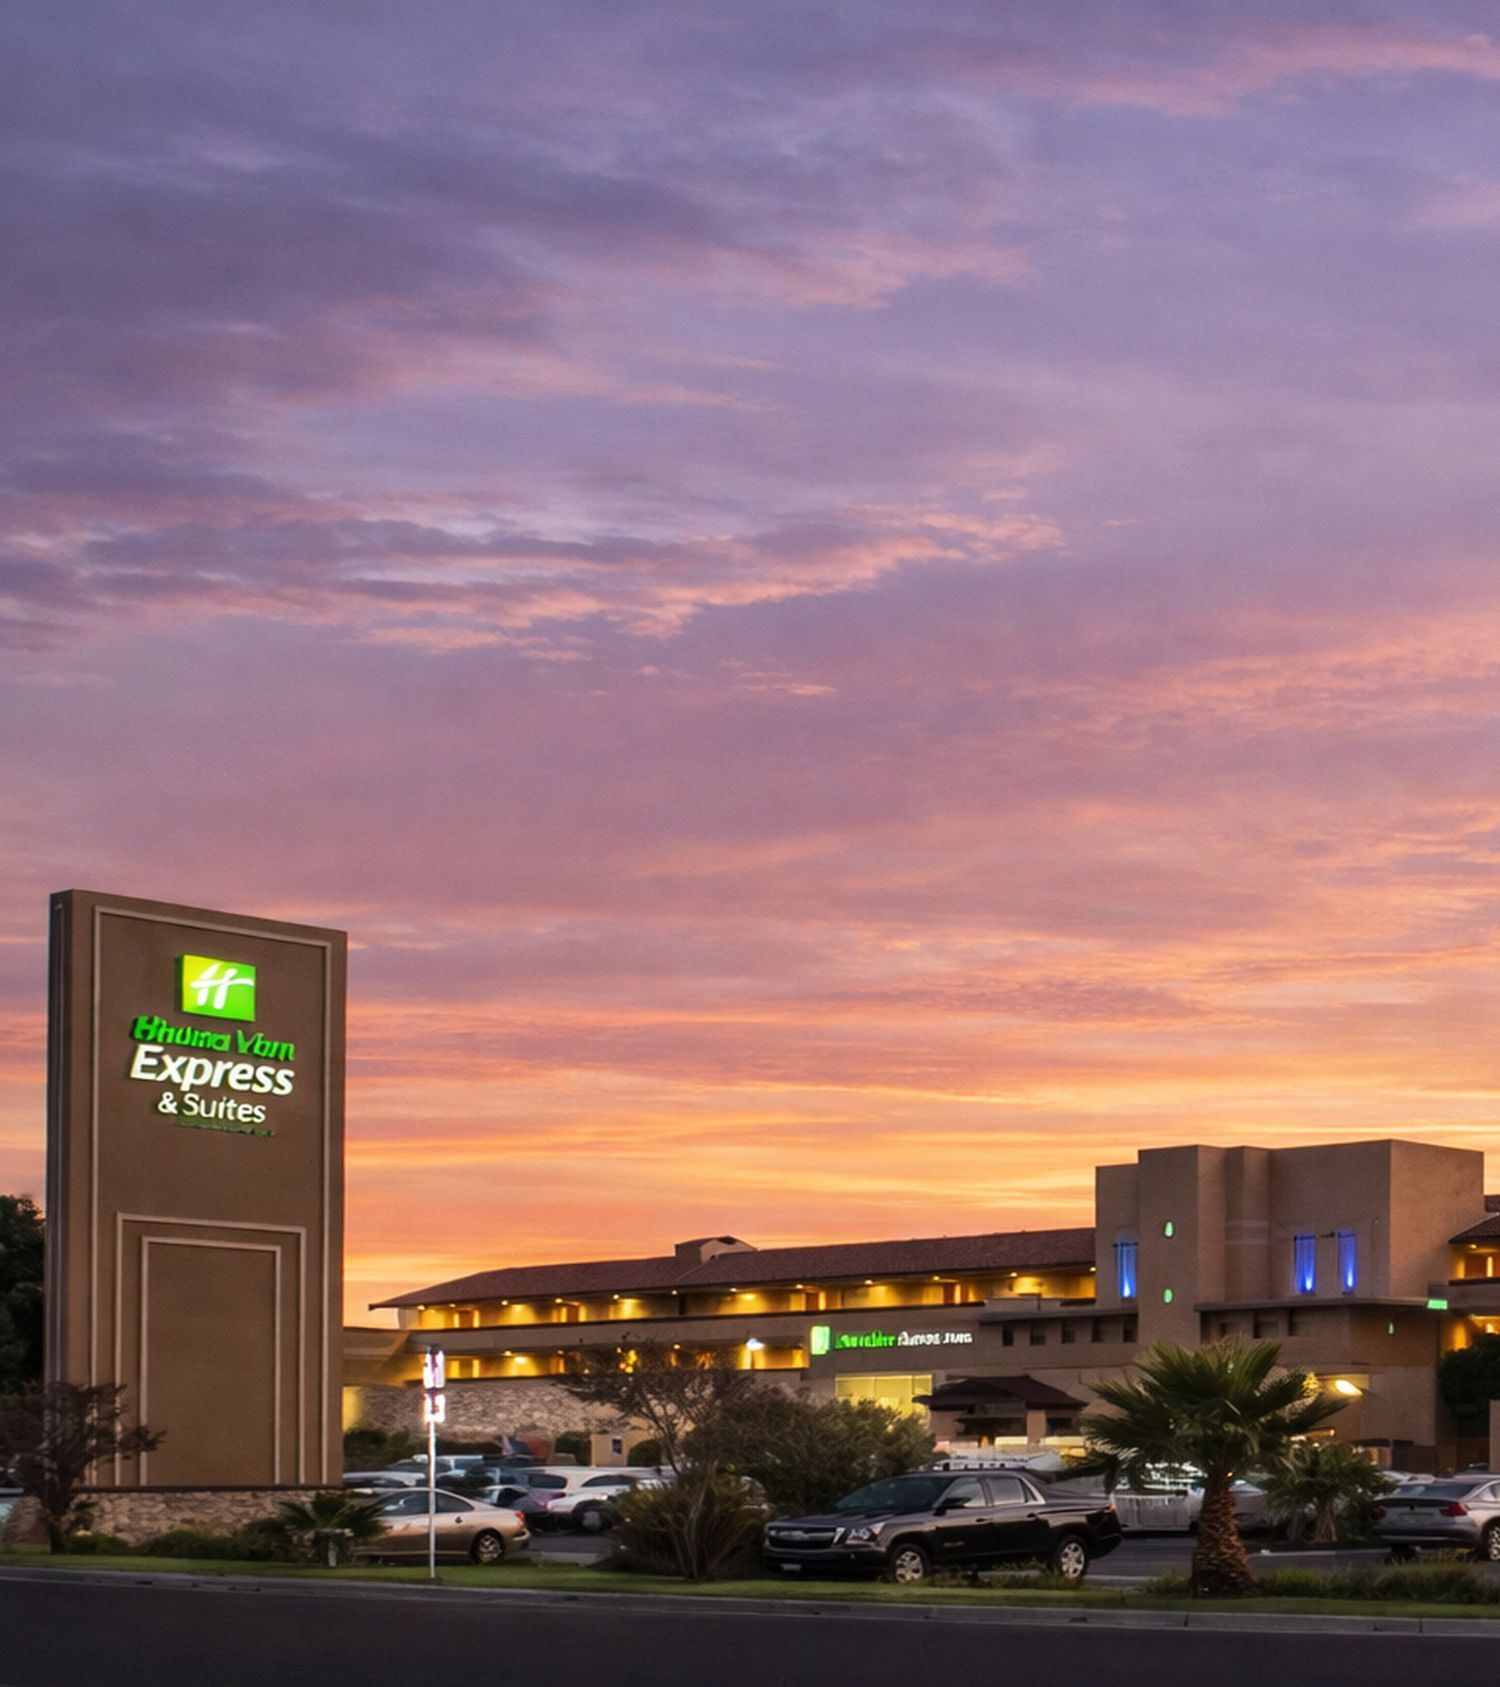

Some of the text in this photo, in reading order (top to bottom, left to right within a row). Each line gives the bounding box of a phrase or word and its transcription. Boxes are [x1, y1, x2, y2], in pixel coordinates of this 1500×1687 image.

[130, 1044, 295, 1095] Express
[158, 1092, 266, 1123] & Suites
